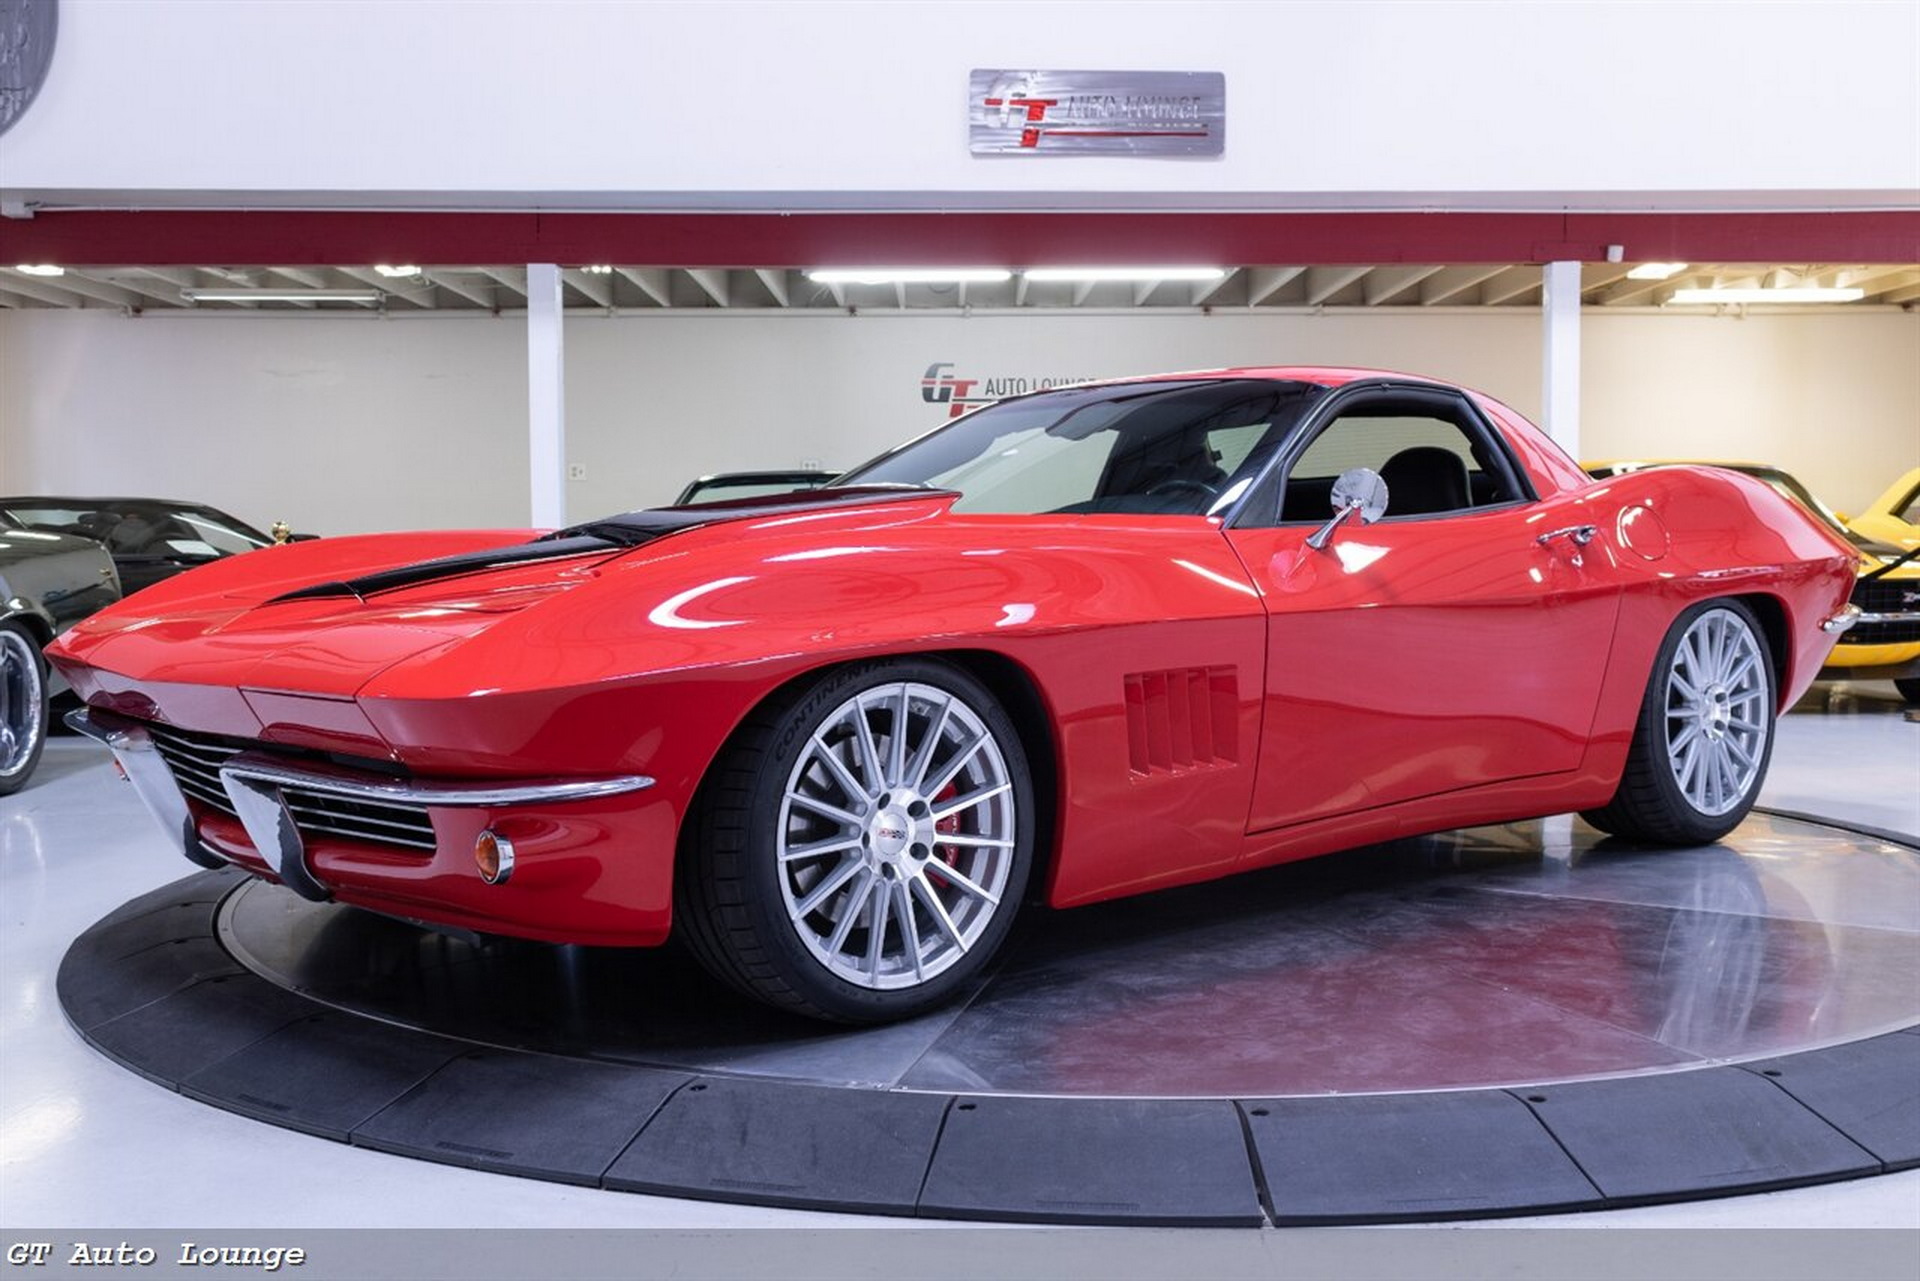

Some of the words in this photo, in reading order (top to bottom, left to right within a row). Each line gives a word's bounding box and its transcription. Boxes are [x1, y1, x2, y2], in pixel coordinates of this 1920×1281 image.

[1067, 96, 1116, 119] AUTO
[922, 363, 978, 417] GT
[985, 378, 1027, 396] AUTO
[775, 659, 897, 761] CONTINENTAL
